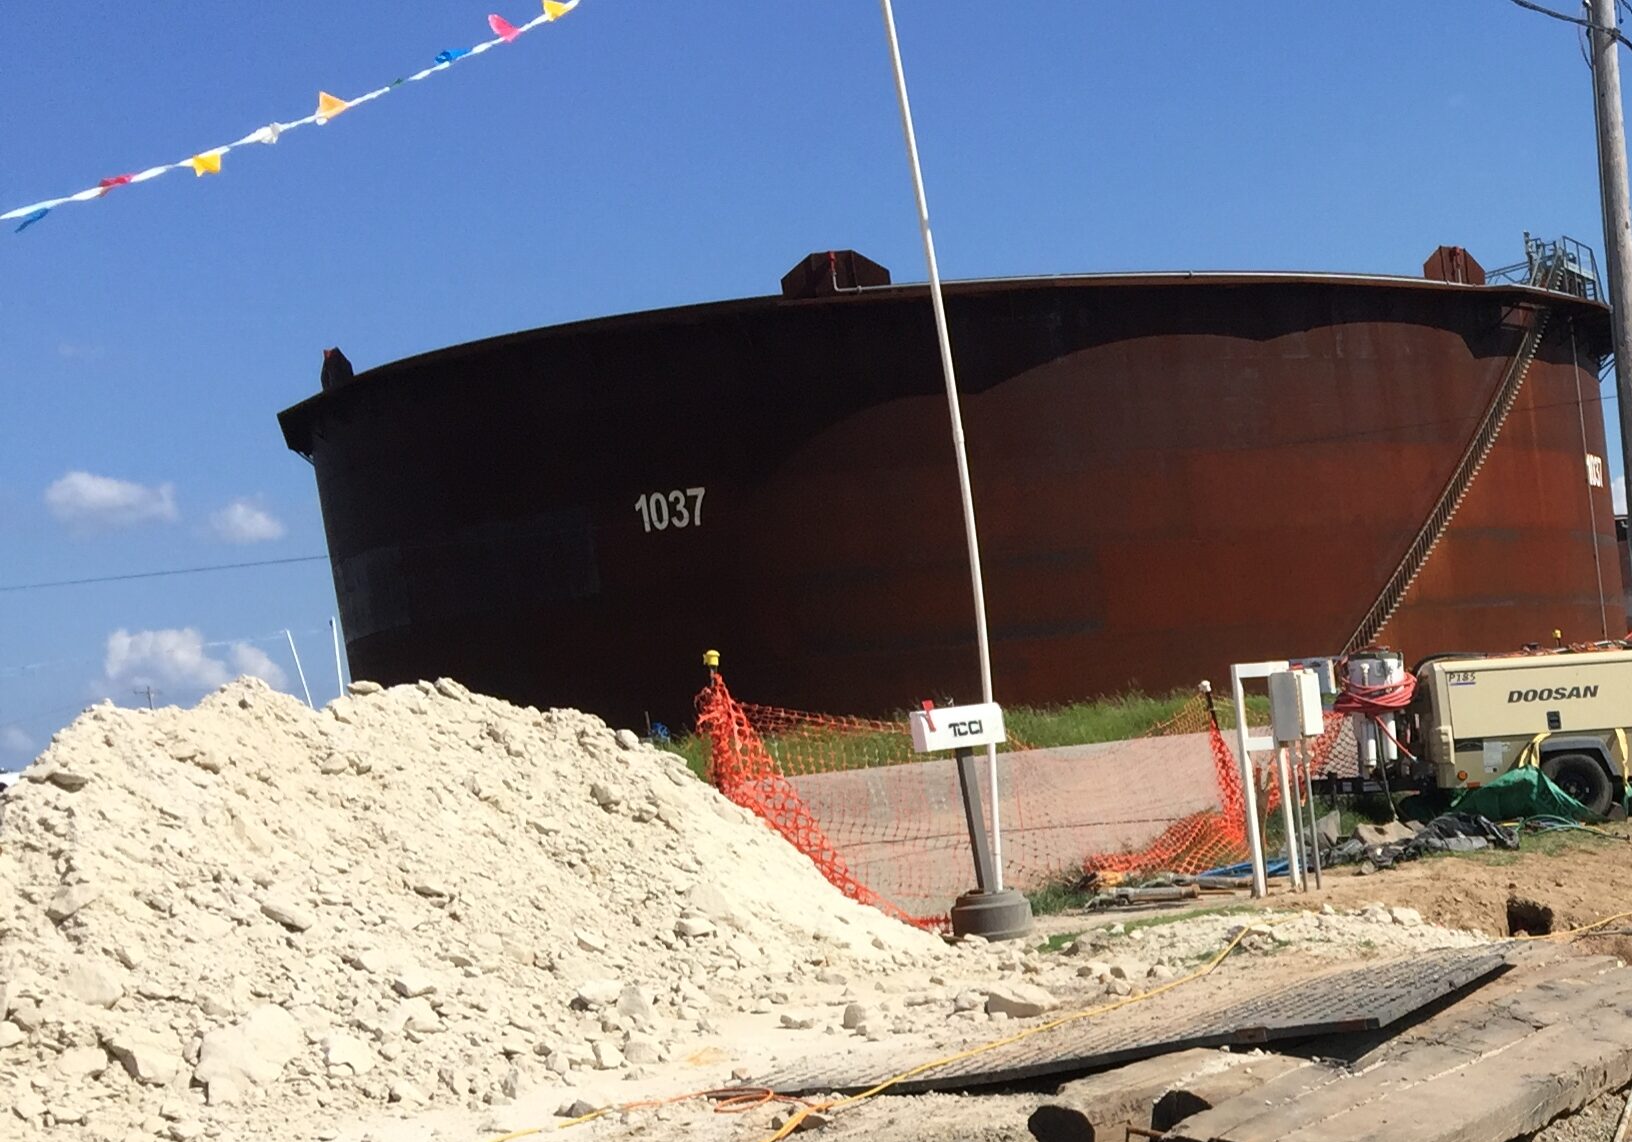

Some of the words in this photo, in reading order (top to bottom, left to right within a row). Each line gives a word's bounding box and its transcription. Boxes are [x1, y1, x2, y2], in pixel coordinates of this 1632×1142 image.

[634, 486, 706, 533] 1037
[1507, 685, 1599, 703] DOOSAN
[948, 719, 984, 738] TCCI
